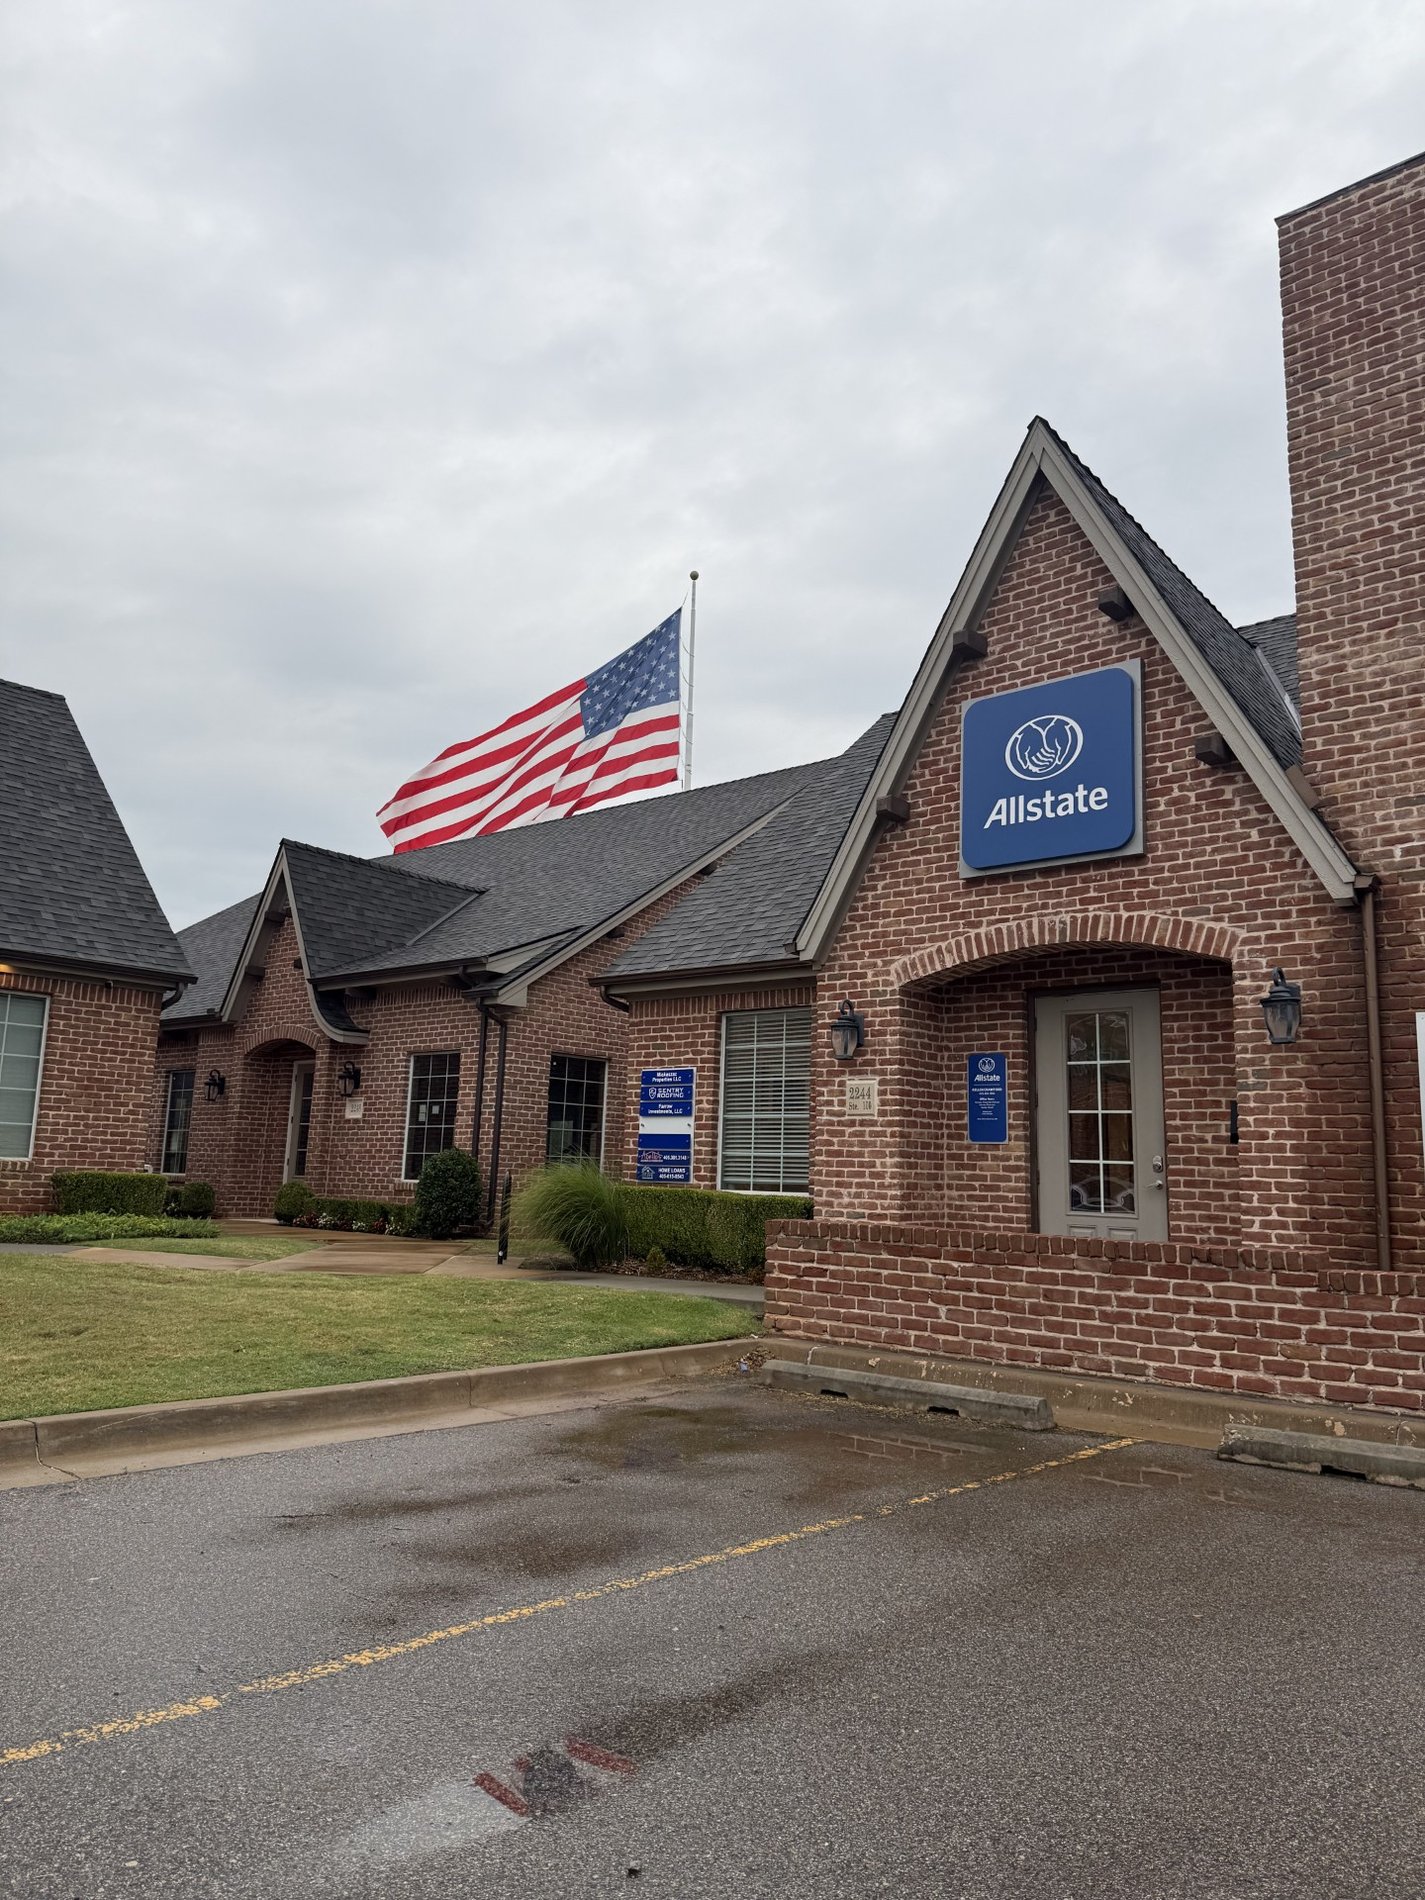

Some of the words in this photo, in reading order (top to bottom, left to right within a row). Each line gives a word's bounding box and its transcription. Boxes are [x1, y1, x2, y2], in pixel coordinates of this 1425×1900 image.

[983, 783, 1108, 830] Allstate
[973, 1074, 1001, 1082] Allstate
[849, 1086, 871, 1100] 2244
